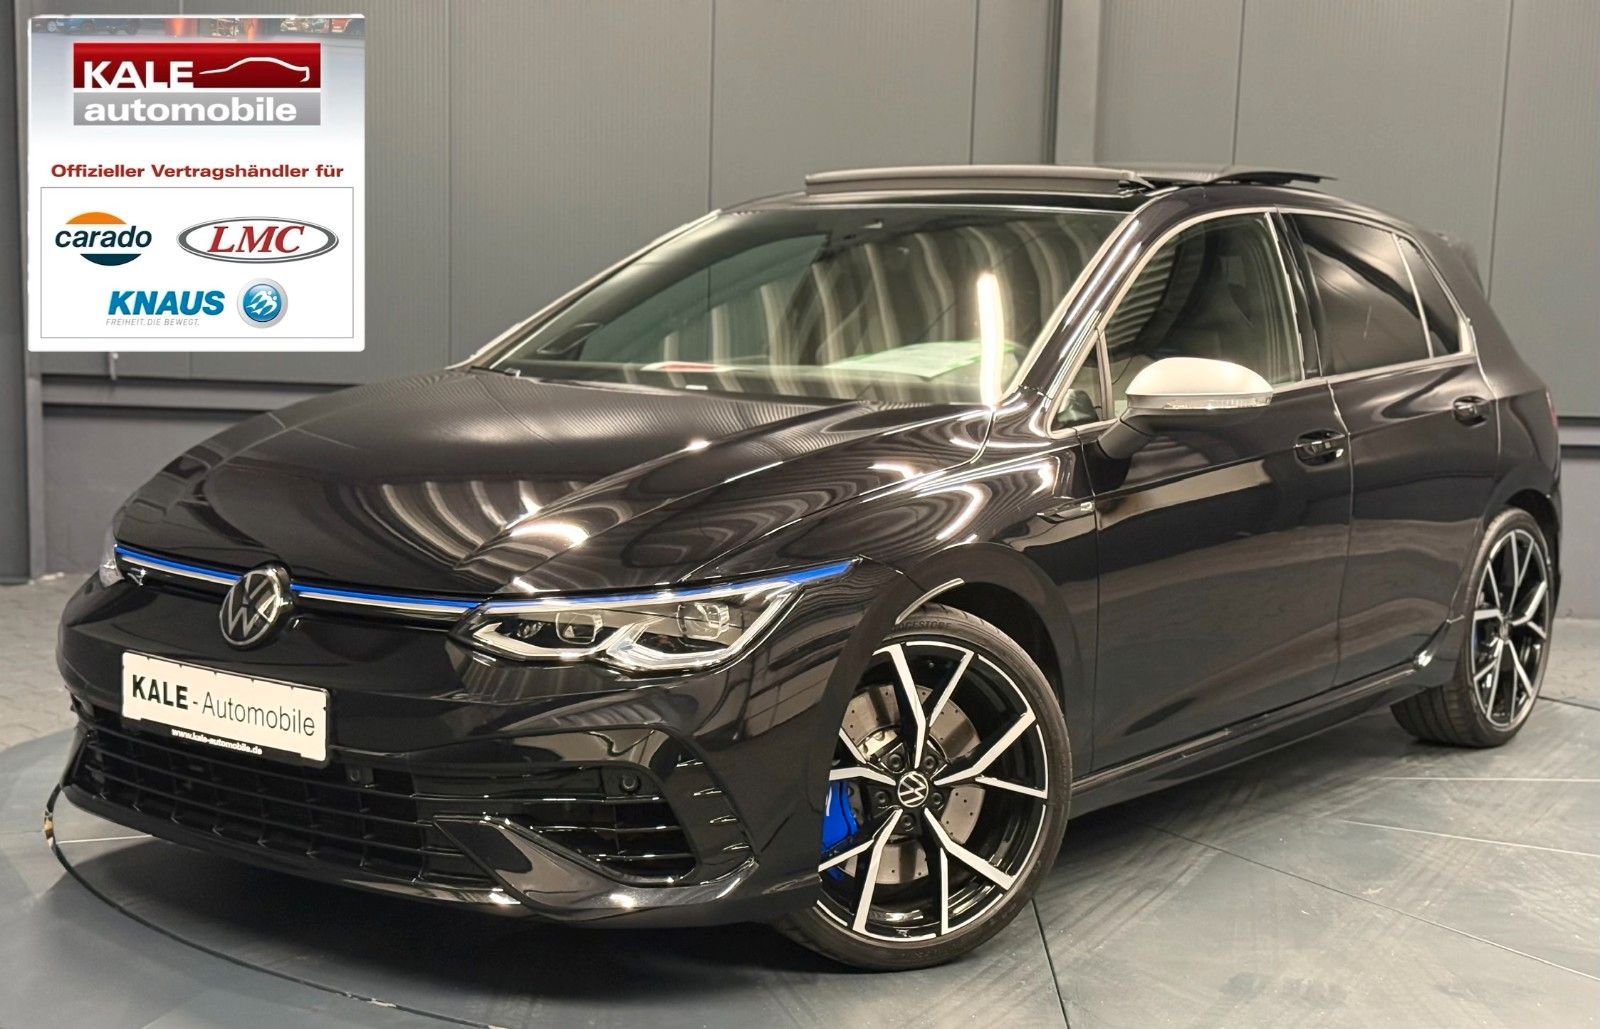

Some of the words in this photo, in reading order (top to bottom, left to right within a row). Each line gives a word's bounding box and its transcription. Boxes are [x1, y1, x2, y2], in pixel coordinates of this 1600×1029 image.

[132, 674, 188, 710] KALE
[202, 691, 315, 737] Automobile
[171, 728, 263, 755] www.kale-automobile.de
